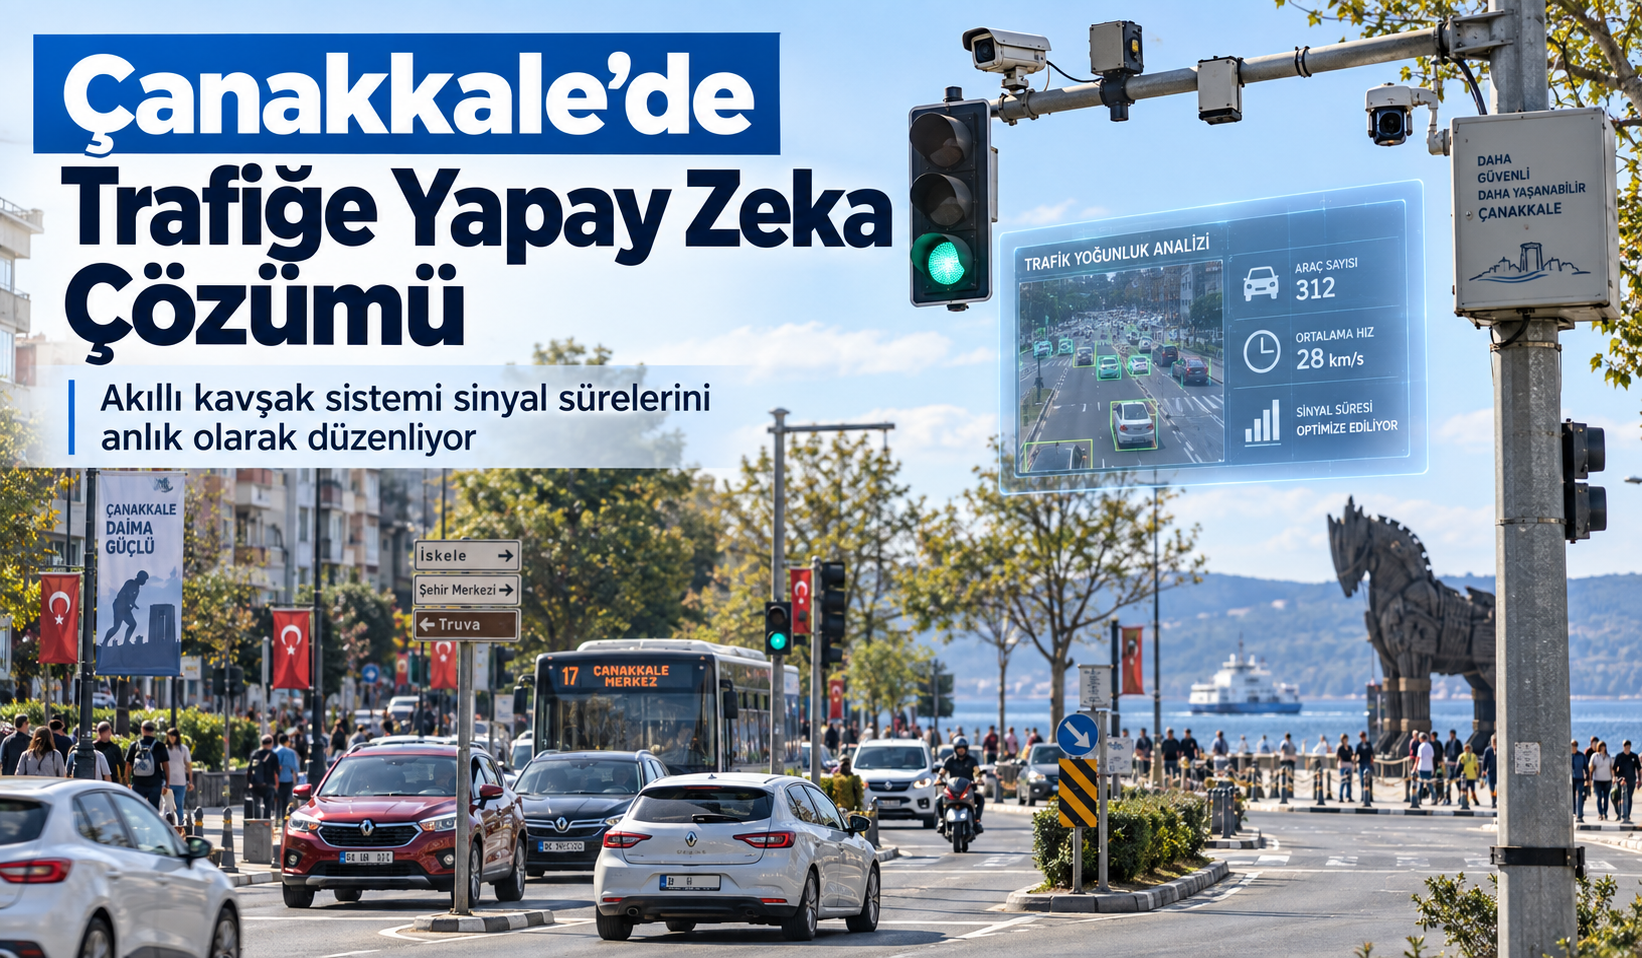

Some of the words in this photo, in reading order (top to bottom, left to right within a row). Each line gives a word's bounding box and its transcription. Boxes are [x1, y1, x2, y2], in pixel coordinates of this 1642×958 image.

[1477, 154, 1512, 167] DAHA
[1477, 167, 1530, 184] GÜVENLİ
[1478, 189, 1510, 201] DAHA
[1513, 181, 1586, 199] YAŞANABİLİR
[1478, 202, 1562, 222] ÇANAKKALE
[1024, 250, 1071, 271] TRAFİK
[1074, 243, 1150, 266] YOĞUNLUK
[1153, 232, 1210, 256] ANALİZİ
[1295, 261, 1323, 274] ARAÇ
[1326, 257, 1358, 271] SAYISI
[1296, 276, 1335, 301] 312
[1295, 328, 1353, 343] ORTALAMA
[1356, 326, 1374, 338] HIZ
[1296, 347, 1324, 370] 28
[1329, 351, 1364, 368] km/s
[1296, 404, 1333, 418] SİNYAL
[1335, 399, 1373, 415] SÜRESİ
[1296, 421, 1346, 436] OPTİMİZE
[1349, 418, 1398, 433] EDİLİYOR
[106, 503, 177, 518] ÇANAKKALE
[106, 518, 153, 536] DAİMA
[105, 536, 155, 557] GÜÇLÜ
[420, 546, 467, 562] İskele
[419, 583, 449, 598] Şehir
[452, 583, 496, 596] Merkezi
[438, 618, 480, 631] Truva
[562, 666, 579, 686] 17
[593, 665, 670, 677] ÇANAKKALE
[605, 676, 658, 687] MERKEZ
